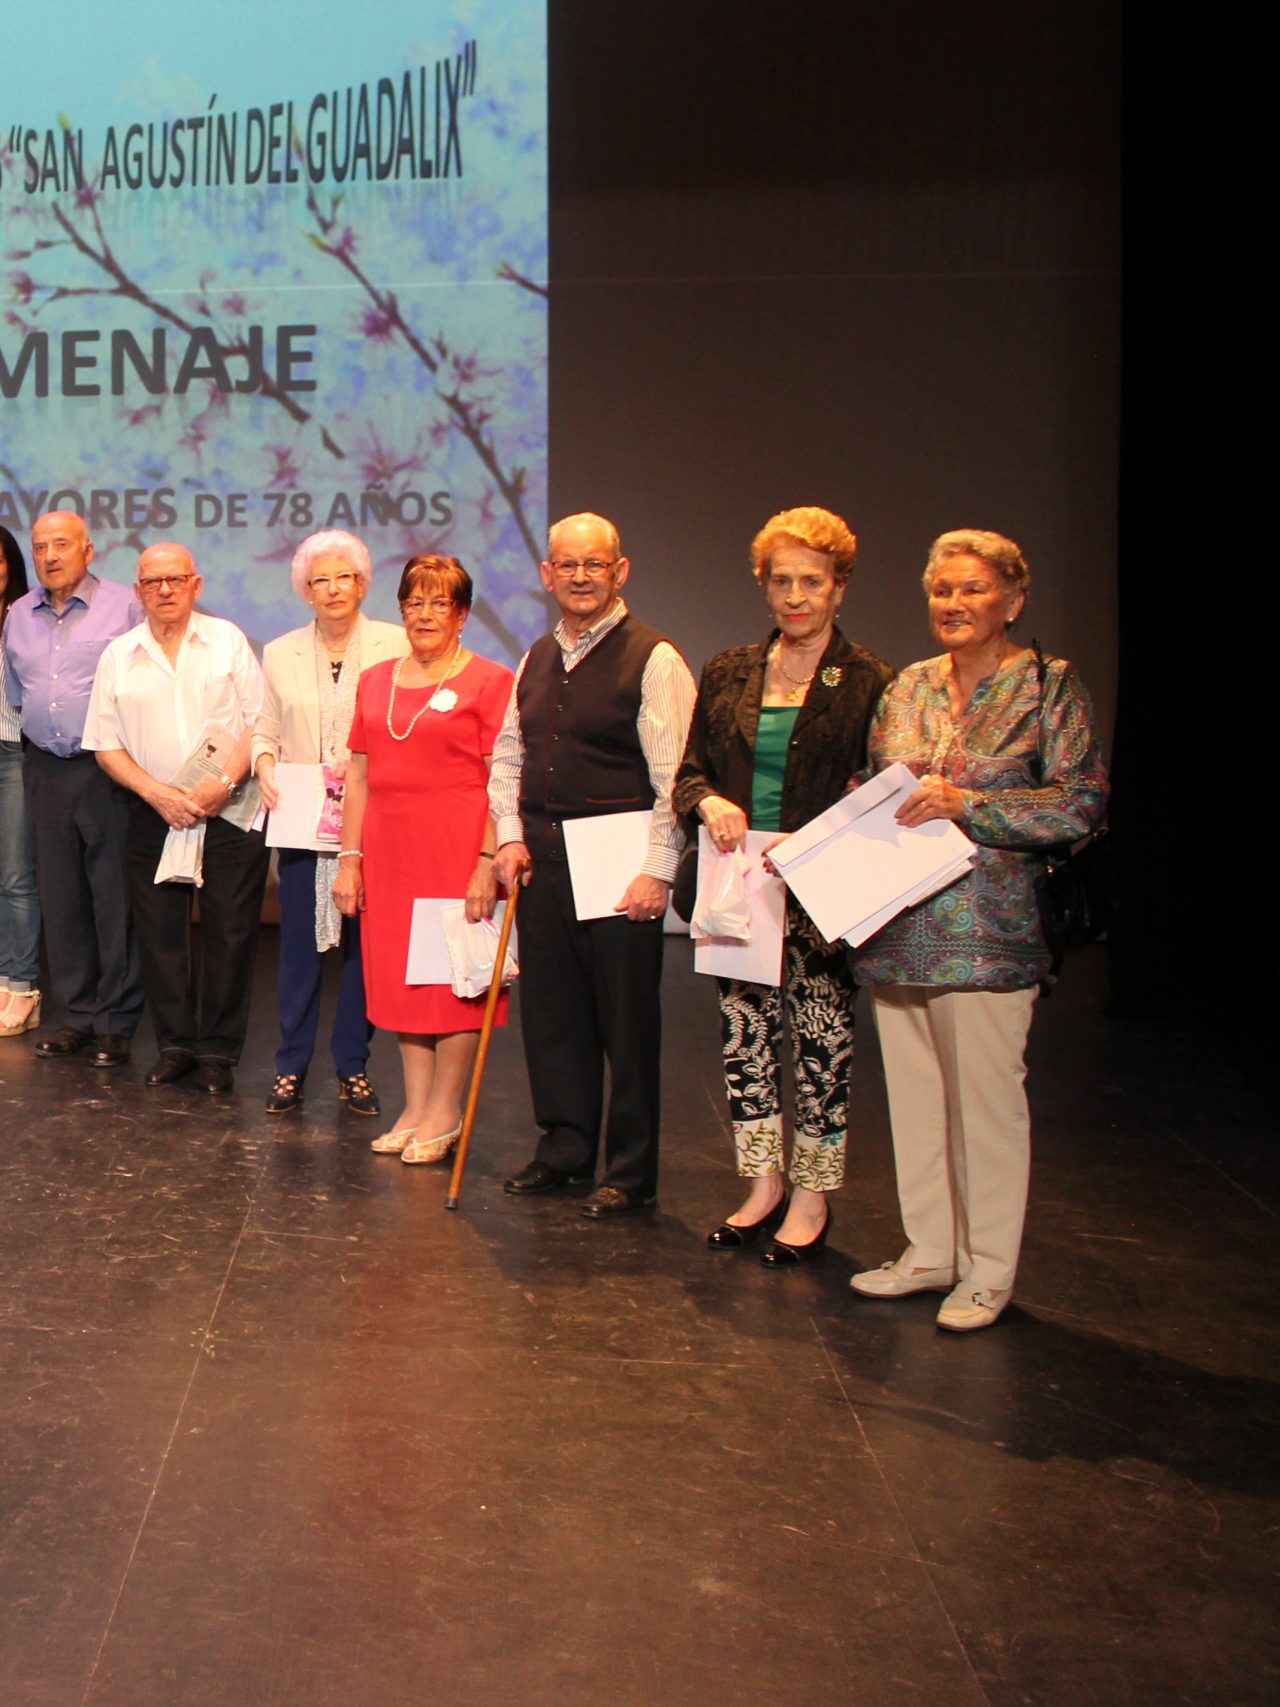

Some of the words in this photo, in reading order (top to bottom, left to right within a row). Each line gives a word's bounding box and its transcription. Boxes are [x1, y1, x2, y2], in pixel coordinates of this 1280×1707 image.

[100, 93, 237, 190] AGUSTÍN
[245, 101, 298, 185] DEL
[194, 493, 249, 528] DE
[263, 493, 314, 527] 78
[326, 482, 454, 527] AÑOS
